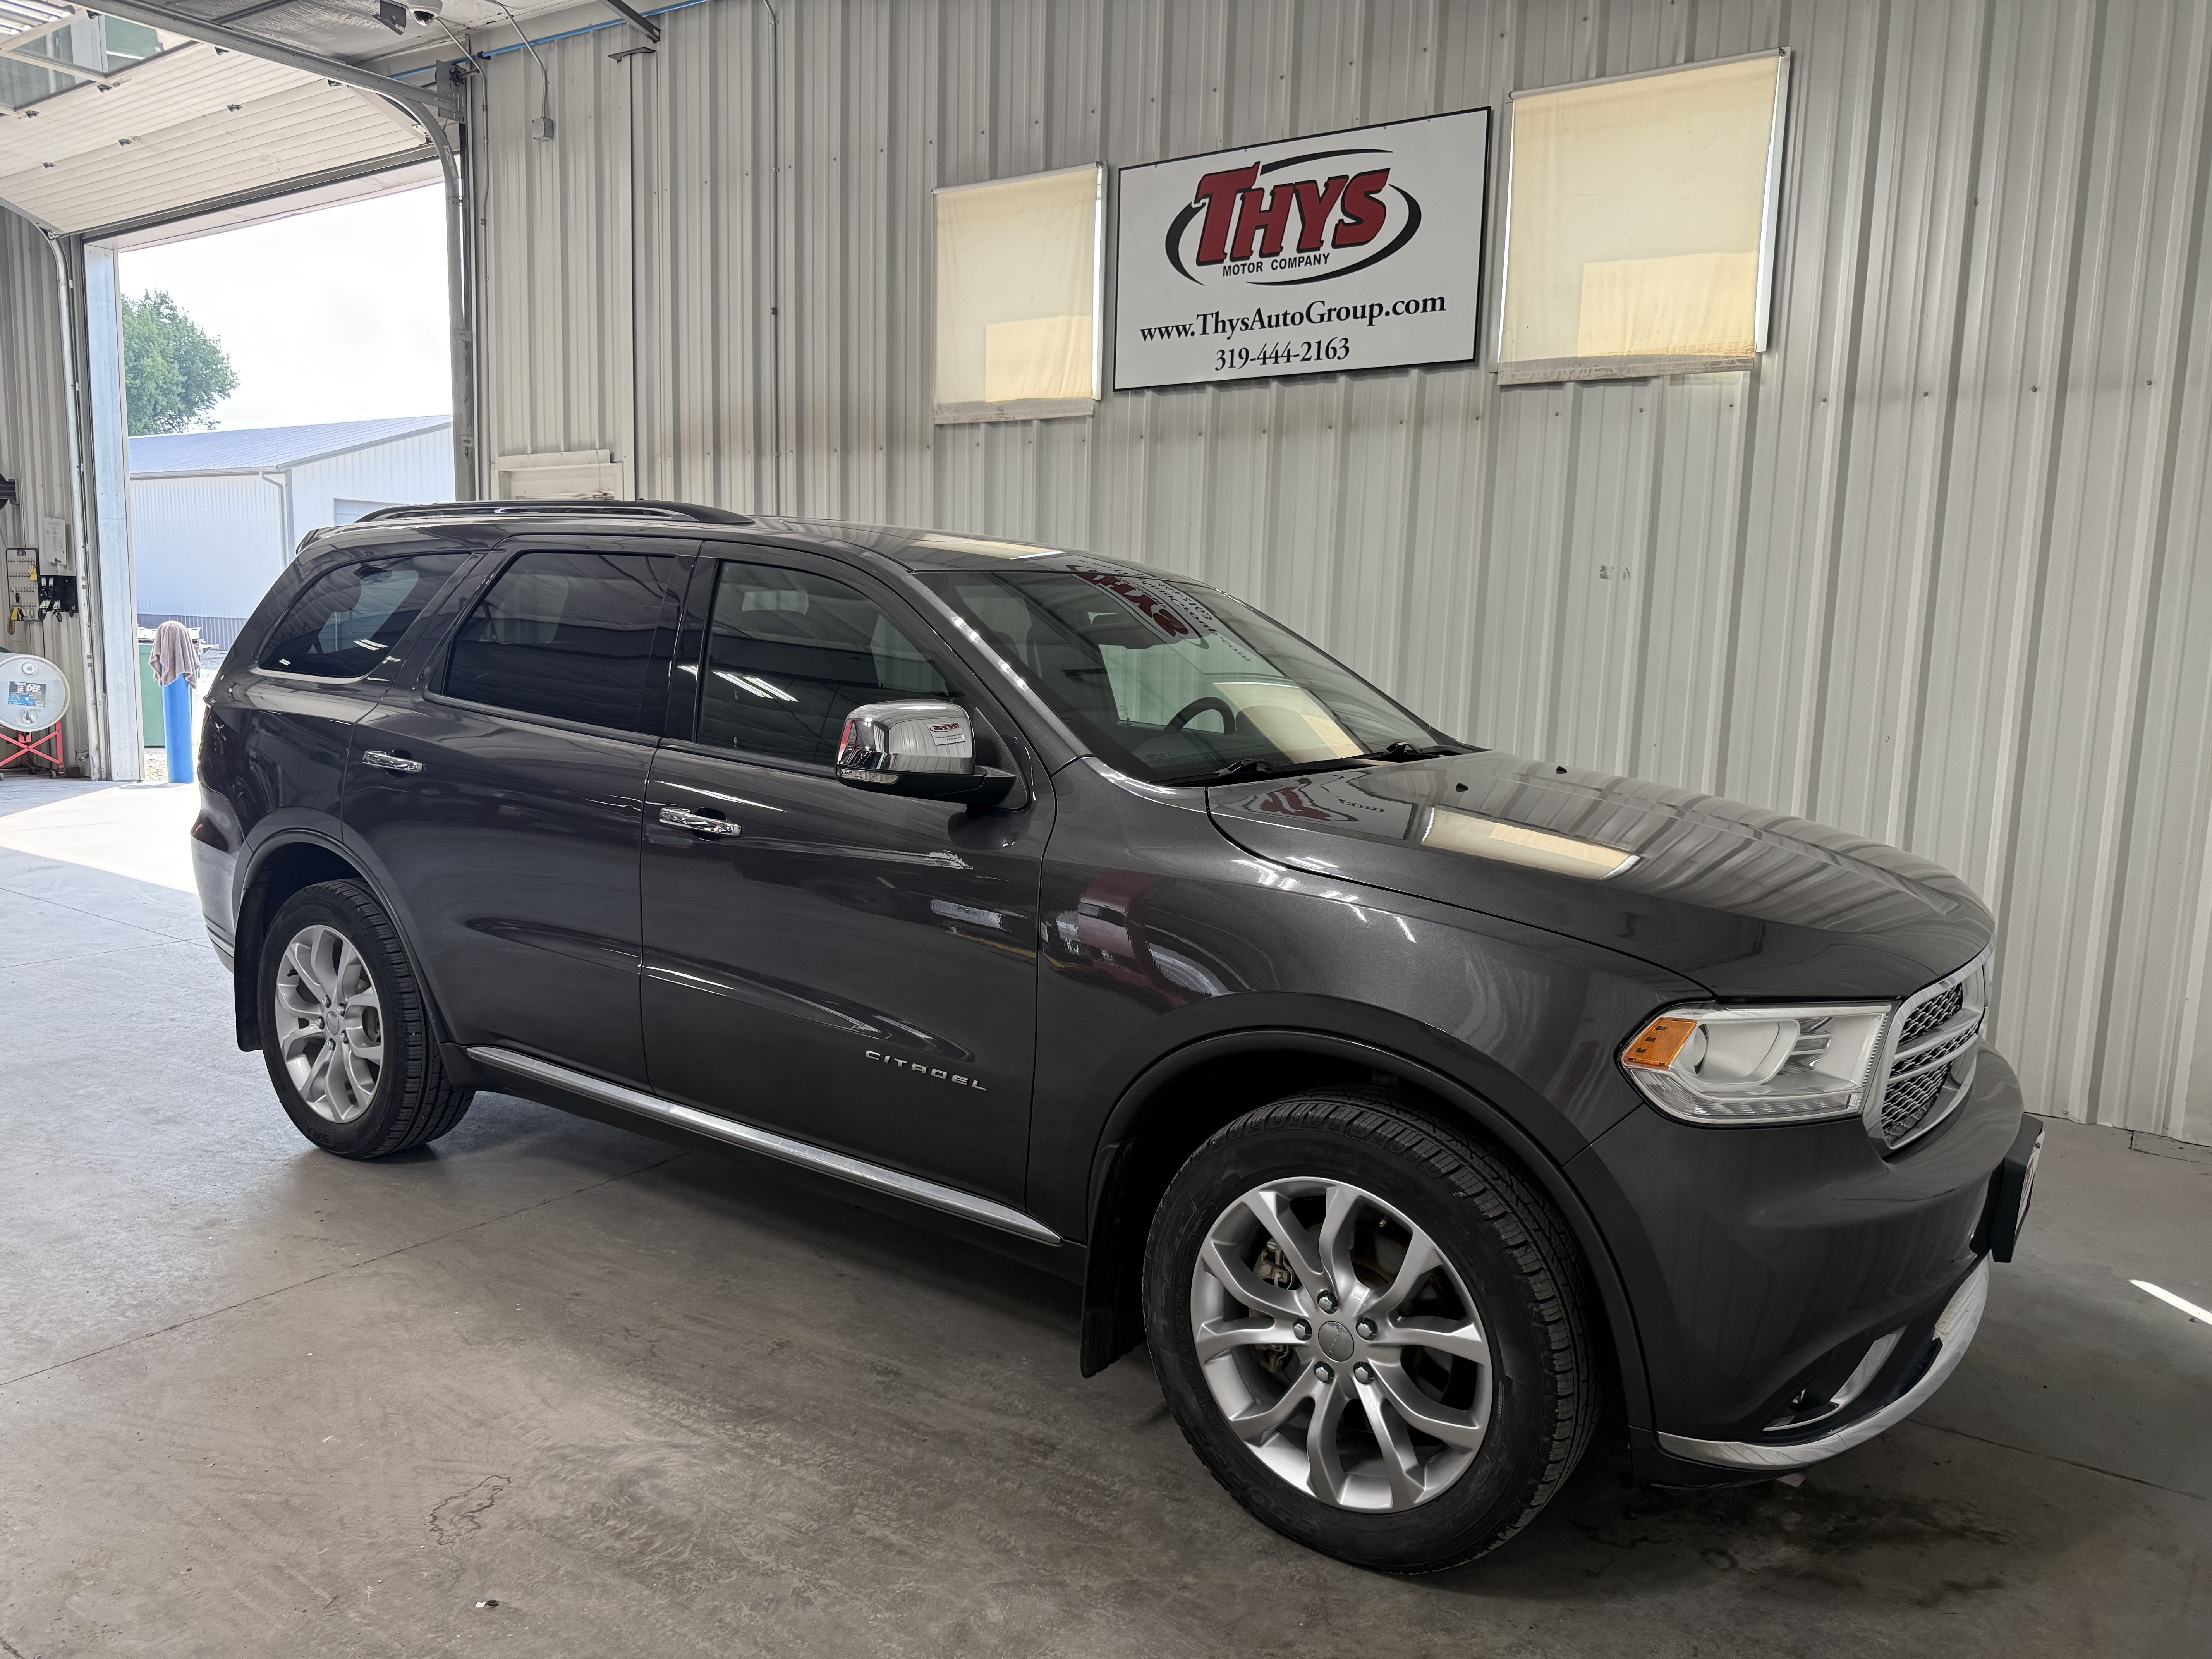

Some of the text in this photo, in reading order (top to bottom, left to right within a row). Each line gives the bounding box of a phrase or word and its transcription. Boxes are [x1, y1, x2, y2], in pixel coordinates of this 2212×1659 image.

[1192, 161, 1391, 267] THYS
[1223, 252, 1331, 276] MOTOR COMPANY
[1139, 295, 1446, 342] www.ThysAutoGroup.com
[1215, 337, 1350, 371] 319-444-2163
[26, 684, 41, 692] DEF
[866, 1050, 988, 1091] CITADEL
